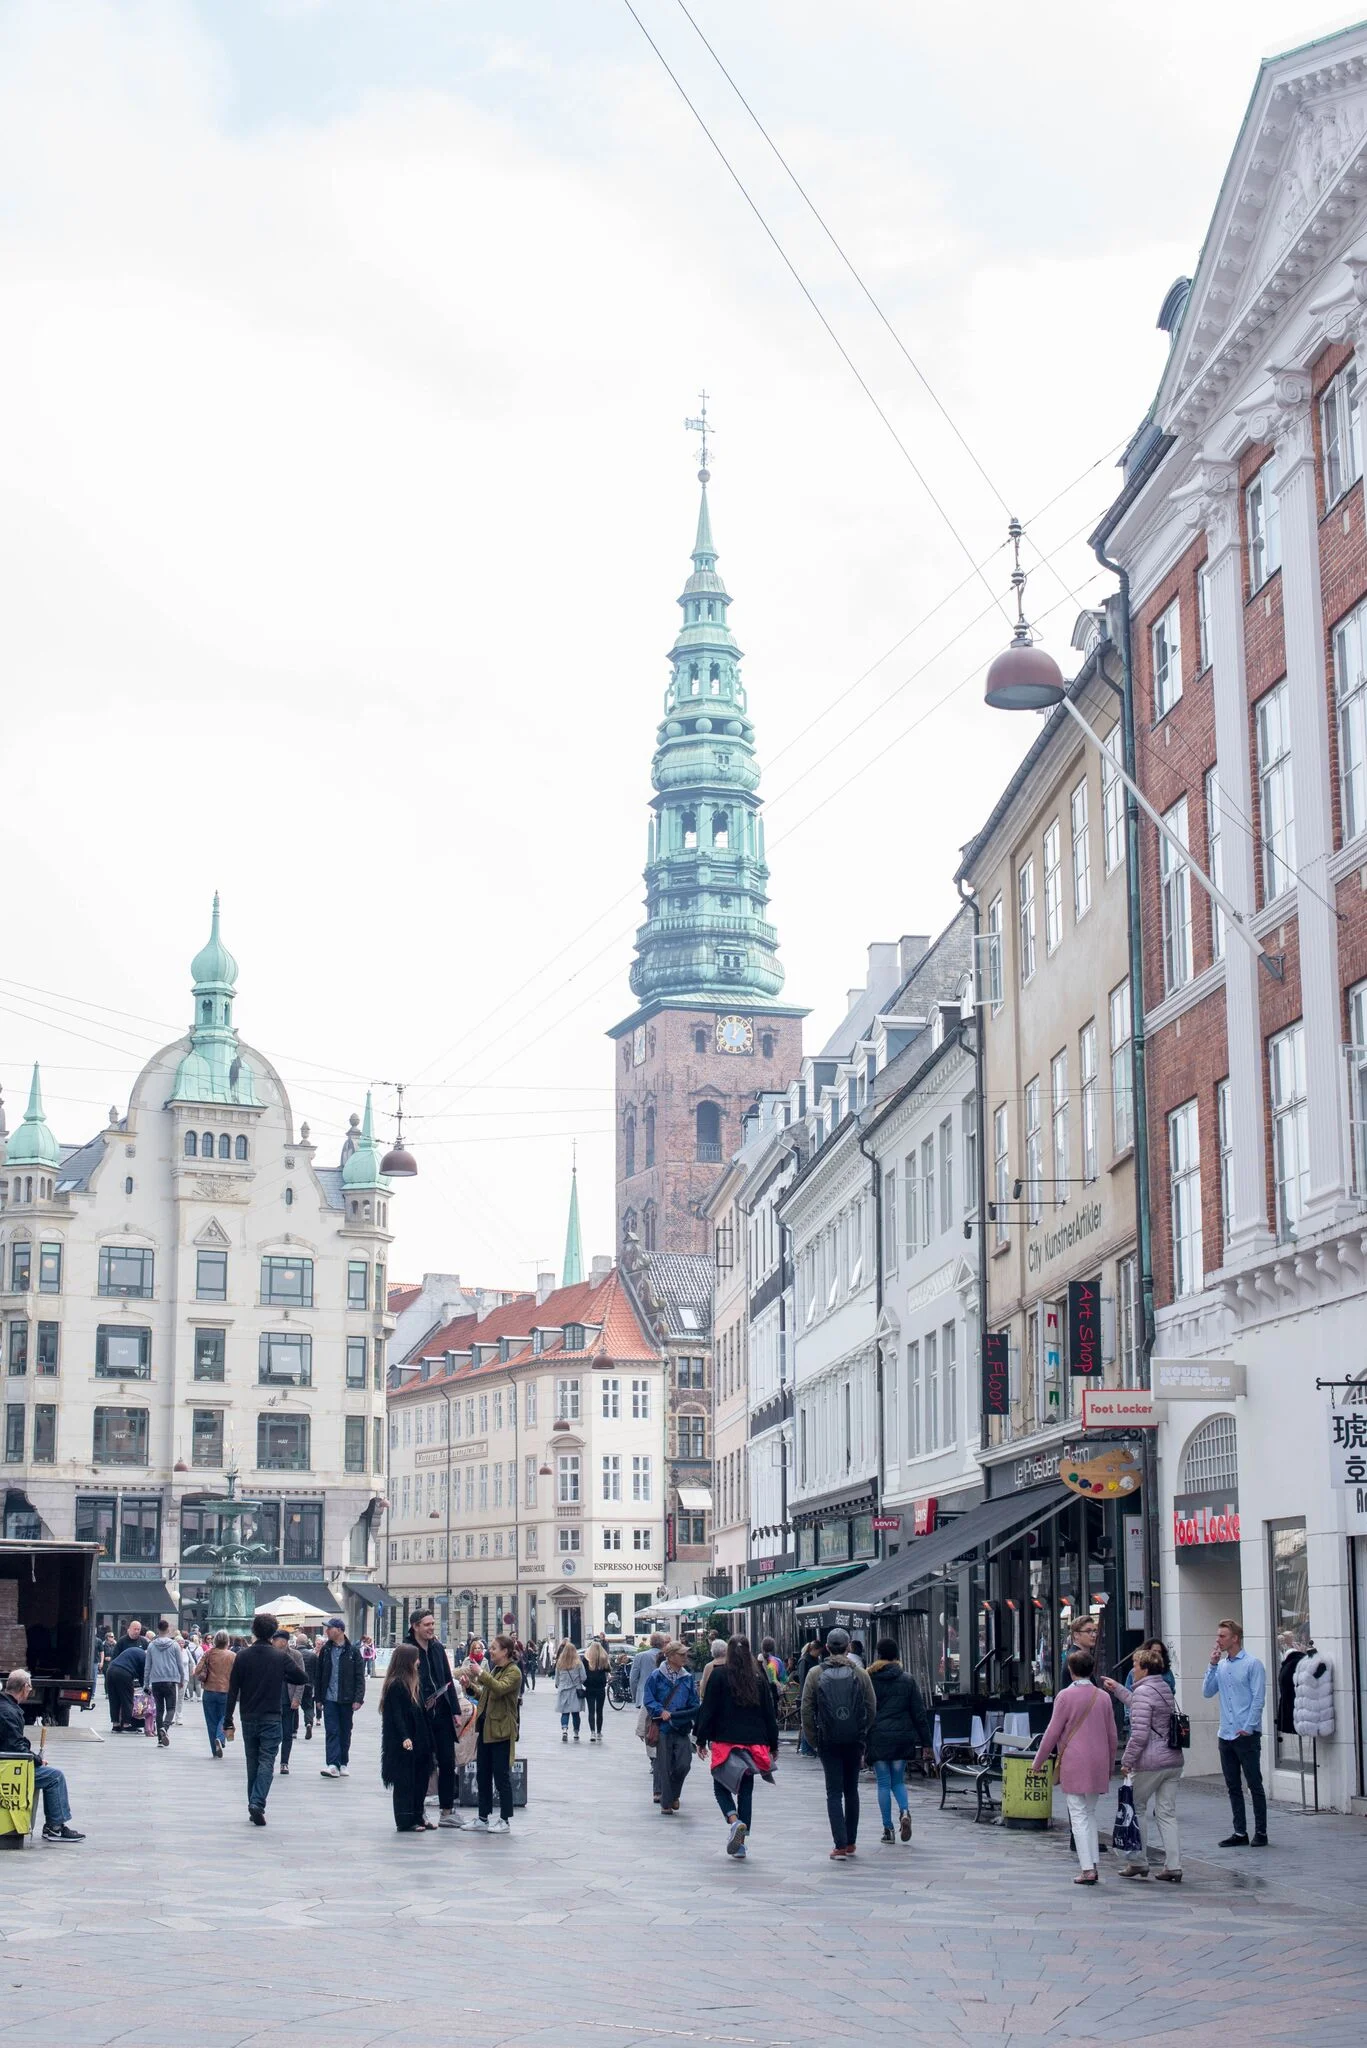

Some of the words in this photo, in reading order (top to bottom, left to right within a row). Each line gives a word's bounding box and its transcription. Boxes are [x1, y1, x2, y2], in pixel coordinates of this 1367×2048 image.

[1028, 1240, 1042, 1274] City
[1079, 1284, 1094, 1320] Art
[987, 1337, 1001, 1357] 1.
[1074, 1324, 1096, 1373] Shop
[987, 1361, 1006, 1413] Floor
[1090, 1403, 1114, 1414] Foot
[1117, 1403, 1153, 1414] Locker
[1014, 1462, 1023, 1485] Le
[594, 1562, 633, 1571] ESPRESSO
[634, 1562, 663, 1571] HOUSE
[0, 1783, 21, 1795] EN
[1025, 1777, 1048, 1788] REN
[1024, 1791, 1048, 1801] KBH
